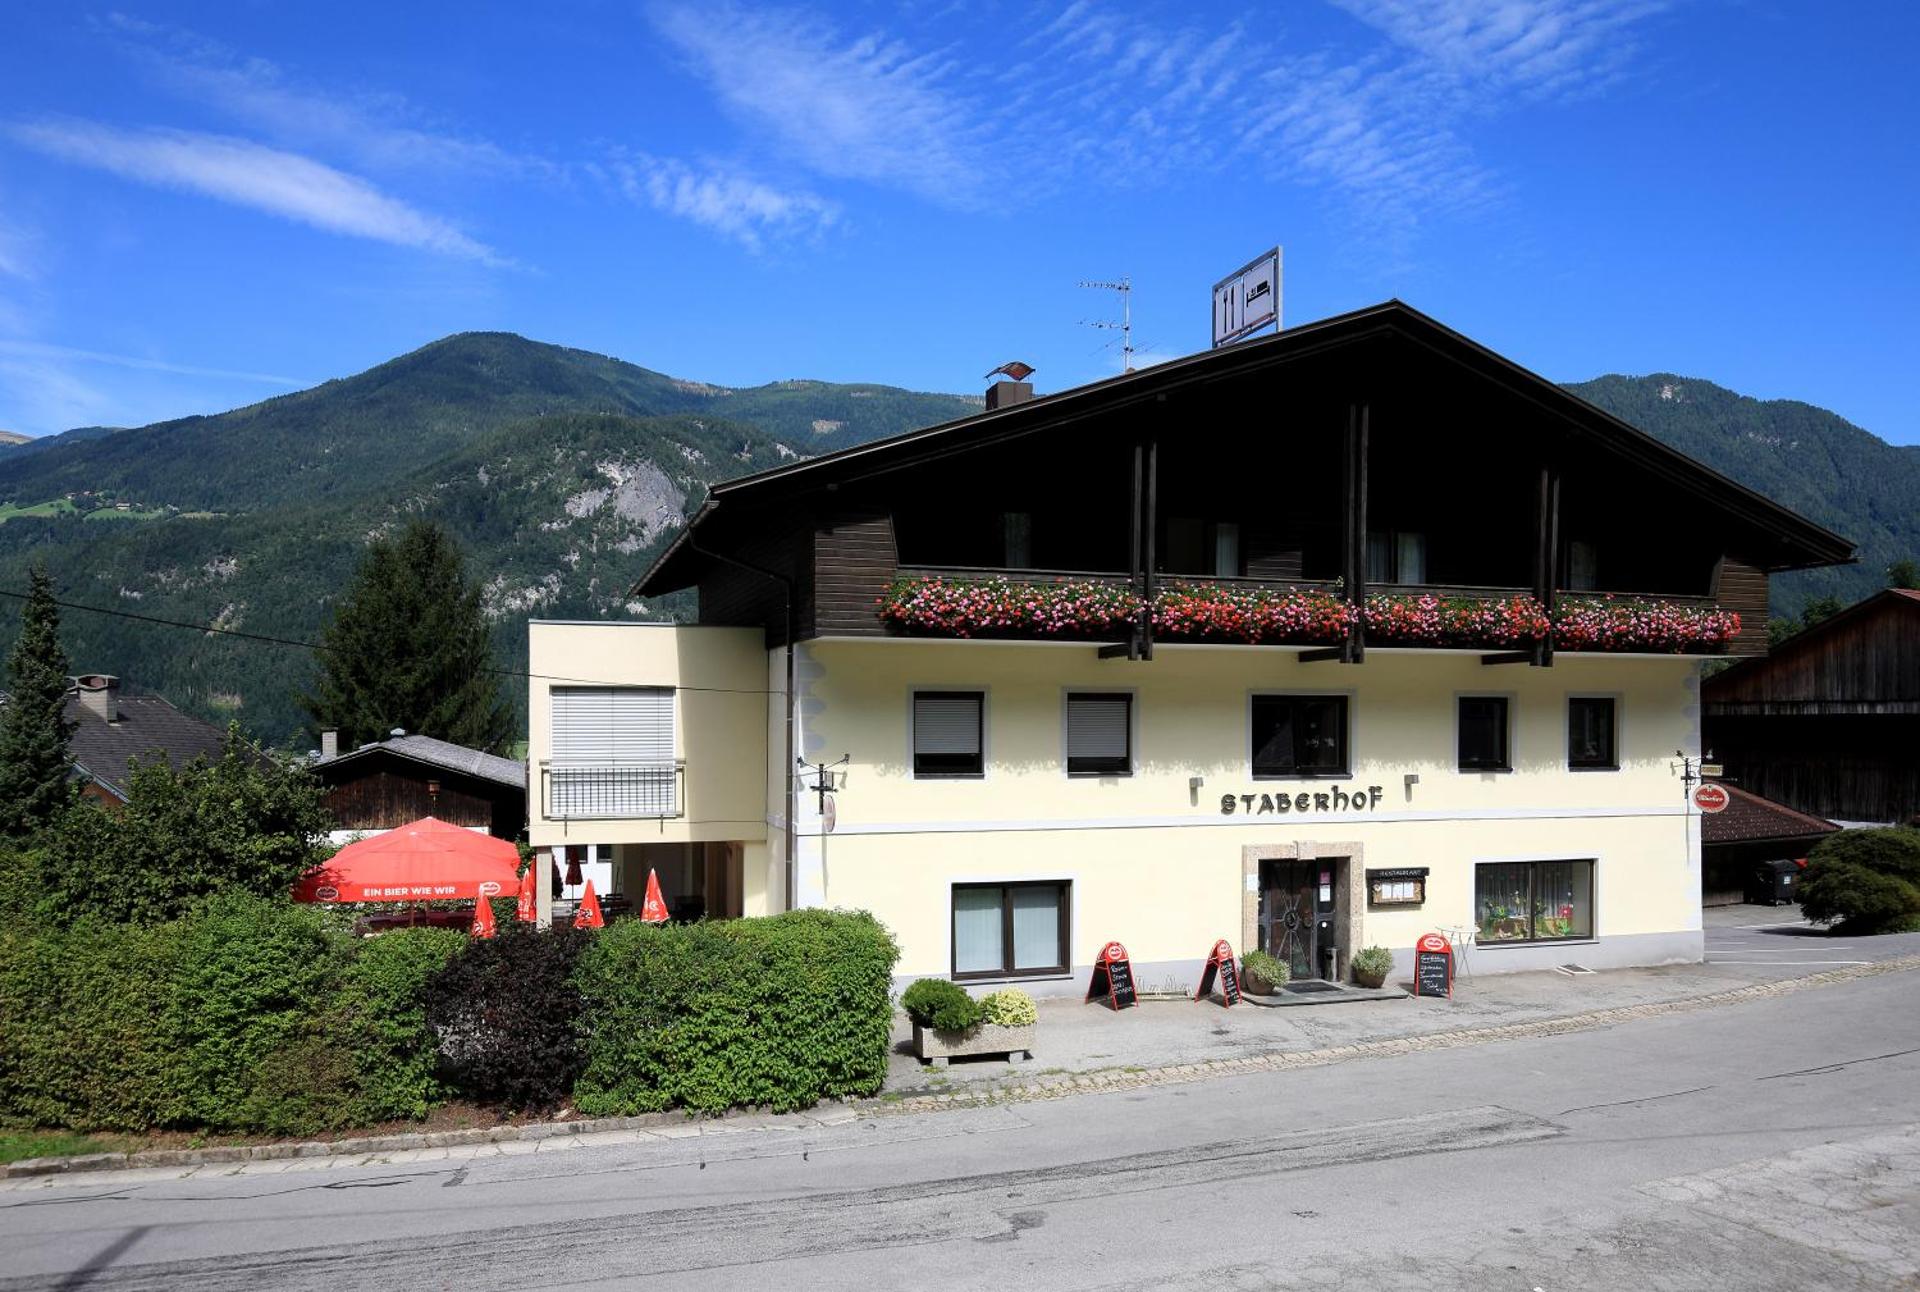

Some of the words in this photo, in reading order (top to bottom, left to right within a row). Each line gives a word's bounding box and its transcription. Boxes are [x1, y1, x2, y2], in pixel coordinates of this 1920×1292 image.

[363, 888, 381, 897] EIN
[384, 887, 408, 896] BIER
[411, 886, 432, 895] WIE
[434, 886, 456, 894] WIR
